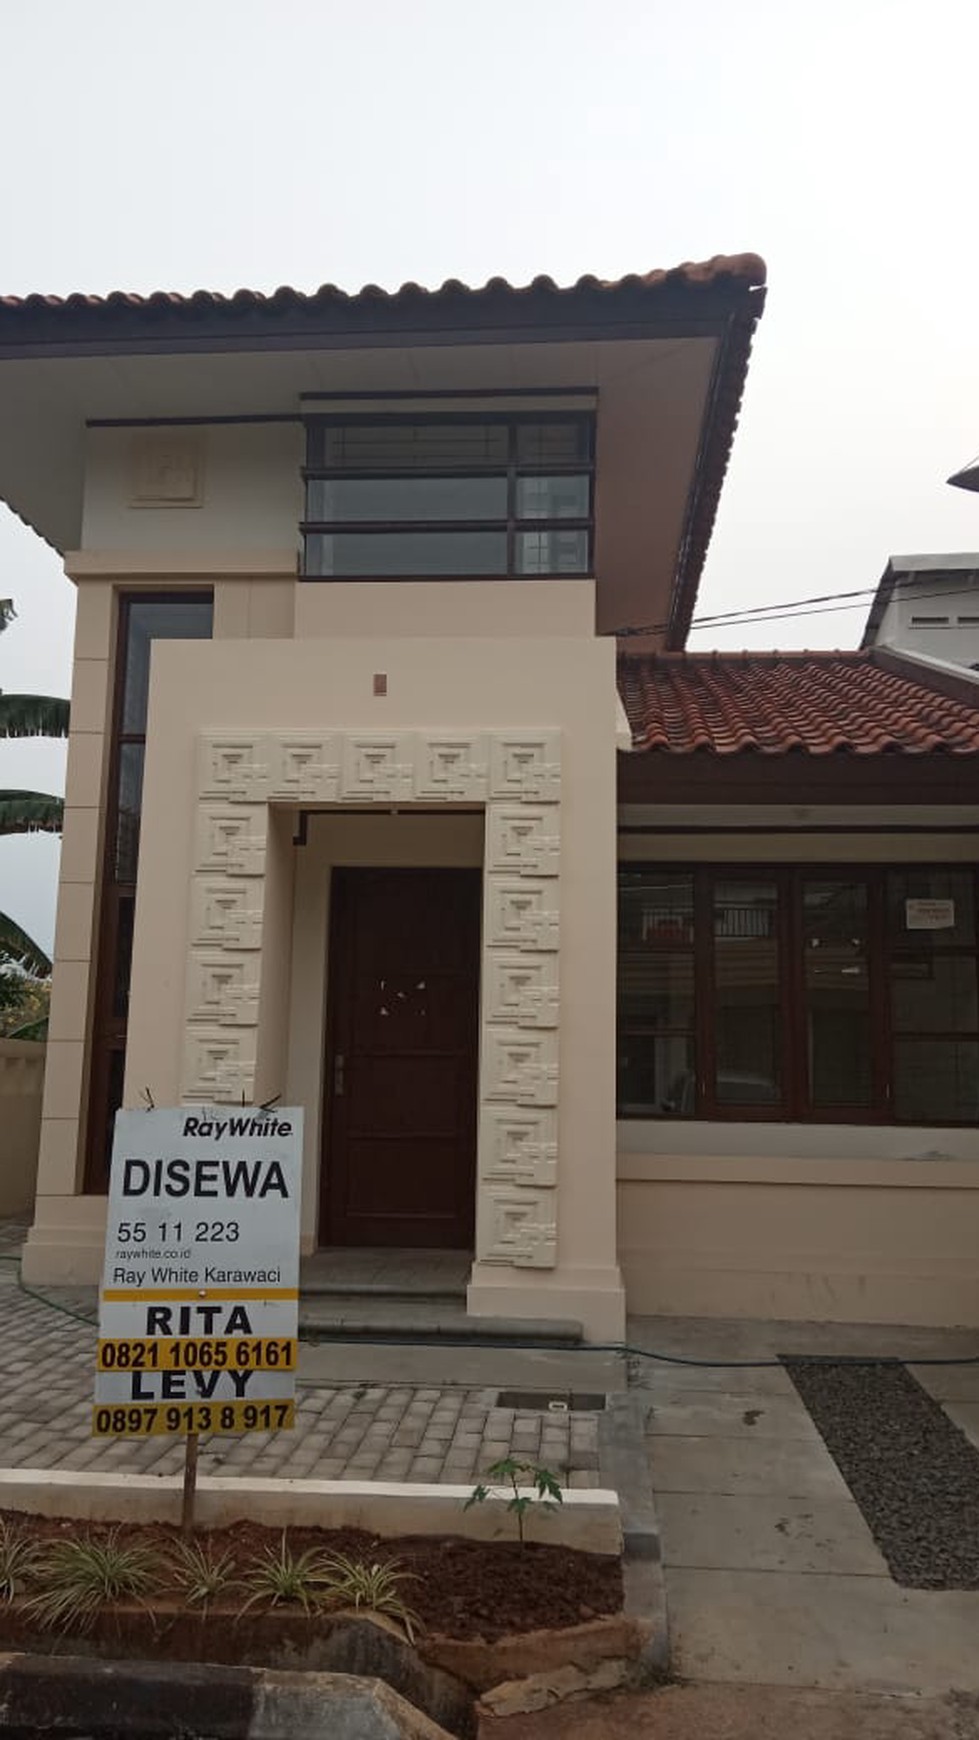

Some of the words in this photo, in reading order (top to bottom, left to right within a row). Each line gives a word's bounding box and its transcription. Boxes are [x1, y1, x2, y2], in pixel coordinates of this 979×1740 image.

[183, 1117, 292, 1141] RayWhite
[122, 1159, 289, 1198] DISEWA
[117, 1222, 146, 1242] 55
[158, 1222, 182, 1242] 11
[195, 1222, 239, 1242] 223
[116, 1249, 191, 1260] raywhite.co.id
[113, 1267, 146, 1287] Ray
[152, 1267, 199, 1283] White
[204, 1267, 281, 1283] Karawaci
[146, 1306, 253, 1335] RITA
[101, 1342, 158, 1367] 0821
[170, 1341, 228, 1367] 1065
[235, 1341, 292, 1366] 6161
[131, 1369, 253, 1400] LEVY
[96, 1408, 158, 1433] 0897
[166, 1406, 212, 1431] 913
[220, 1405, 235, 1429] 8
[243, 1405, 289, 1429] 917
